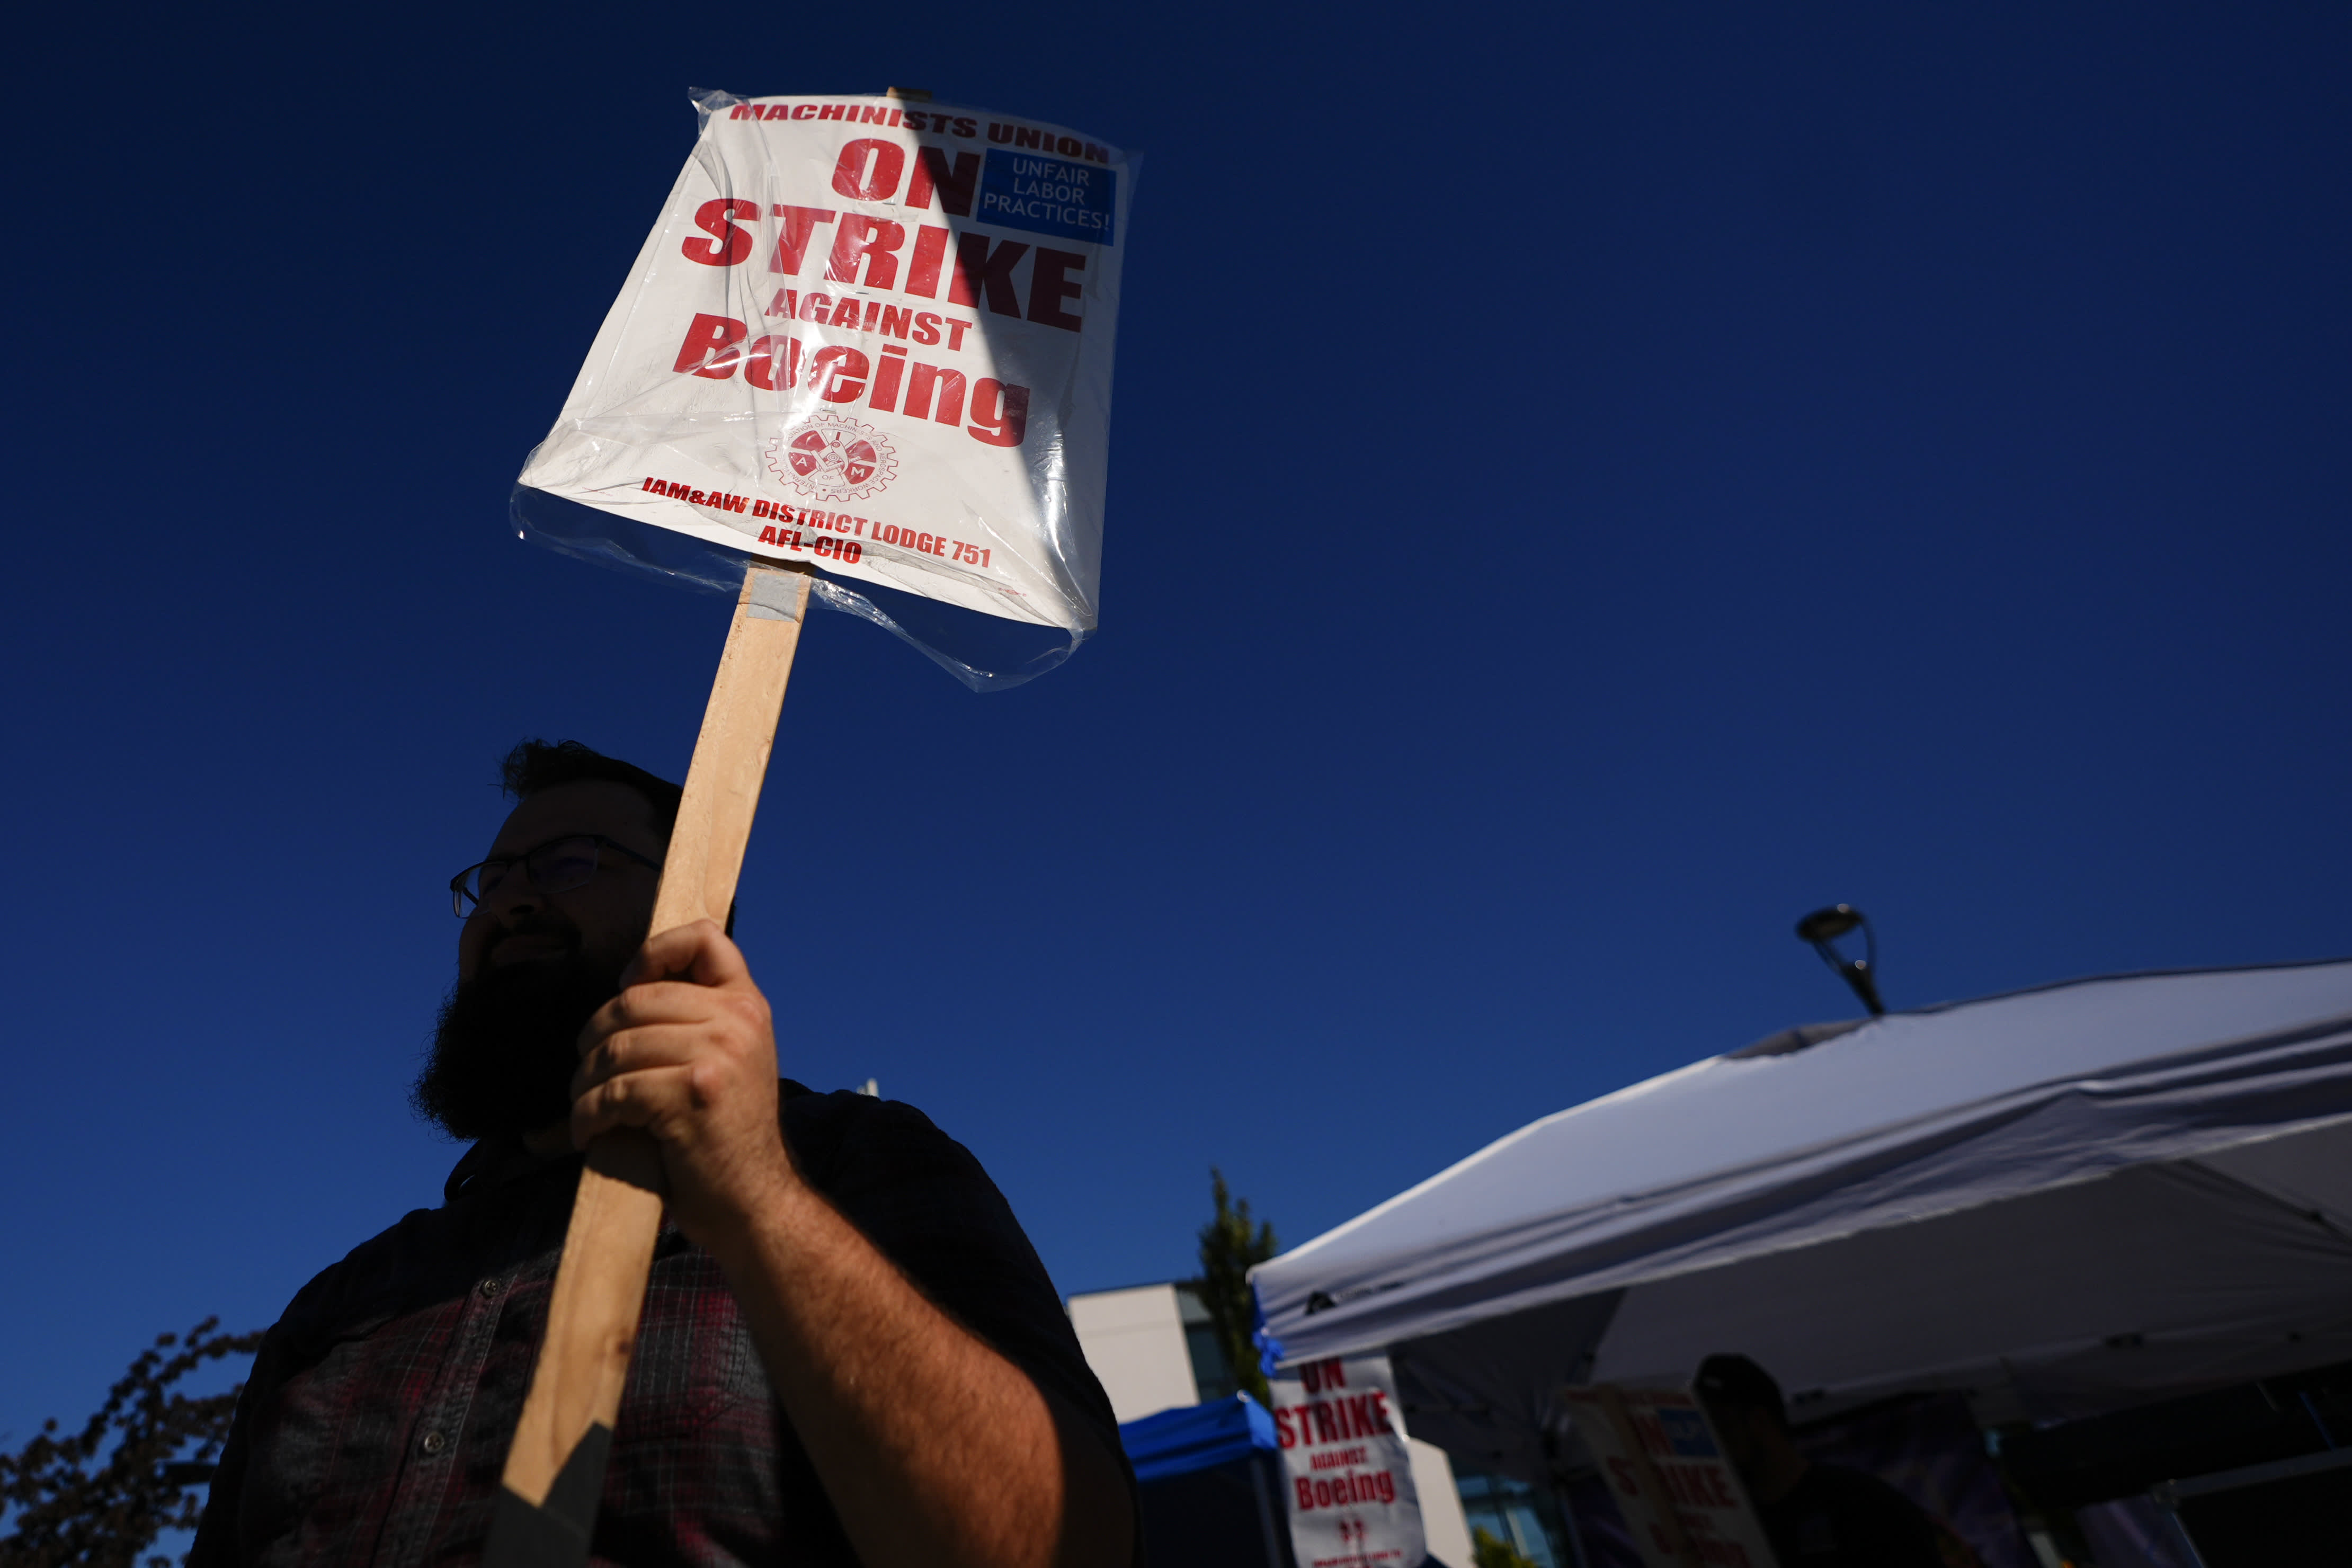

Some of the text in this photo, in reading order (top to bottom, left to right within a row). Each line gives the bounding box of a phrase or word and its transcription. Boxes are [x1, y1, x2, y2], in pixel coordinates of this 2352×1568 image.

[729, 104, 1109, 164] MACHINISTS UNION
[831, 138, 981, 217] ON
[1012, 156, 1090, 186] UNFAIR
[1013, 177, 1085, 206] LABOR
[983, 192, 1111, 232] PRACTICES!
[681, 198, 1086, 333] STRIKE
[764, 289, 972, 352] AGAINST
[672, 312, 1031, 448] Boeing
[795, 457, 808, 467] A
[850, 466, 866, 478] M
[869, 453, 887, 485] AEROSPACE
[831, 483, 870, 494] WORKERS
[641, 477, 991, 568] IAM&AW DISTRICT LODGE 751
[758, 524, 862, 565] AFL-CIO
[1276, 1393, 1394, 1448] STRIKE
[1296, 1471, 1394, 1509] Boeing
